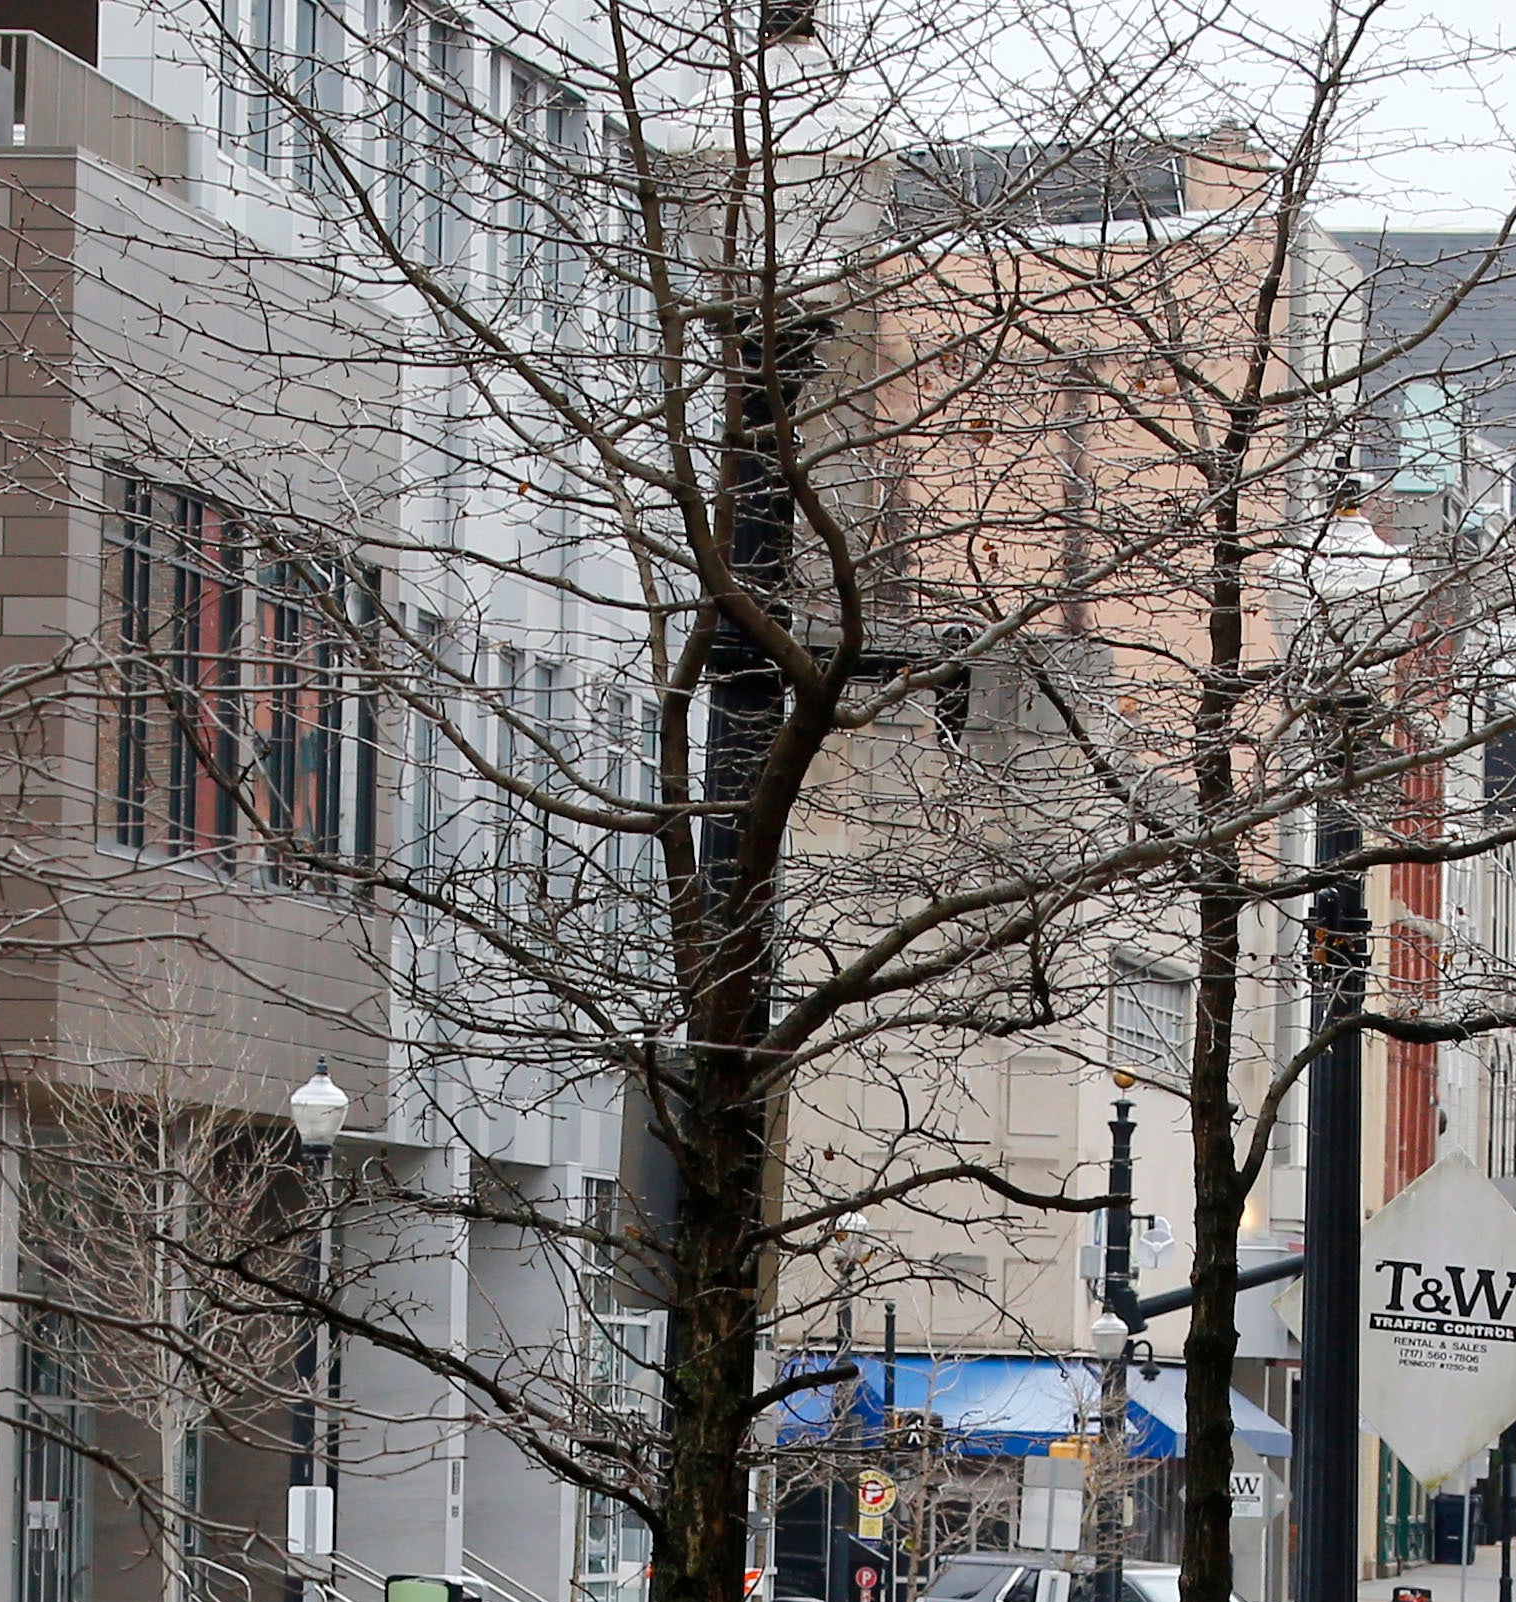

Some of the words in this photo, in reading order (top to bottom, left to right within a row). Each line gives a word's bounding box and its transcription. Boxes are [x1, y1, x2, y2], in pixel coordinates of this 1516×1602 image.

[1373, 1316, 1437, 1332] TRAFFIC
[1443, 1322, 1515, 1340] CONTROL
[1393, 1336, 1434, 1348] RENTAL
[1439, 1341, 1446, 1349] &
[1452, 1342, 1488, 1353] SALES
[1399, 1348, 1423, 1359] (717)
[862, 1571, 872, 1585] P
